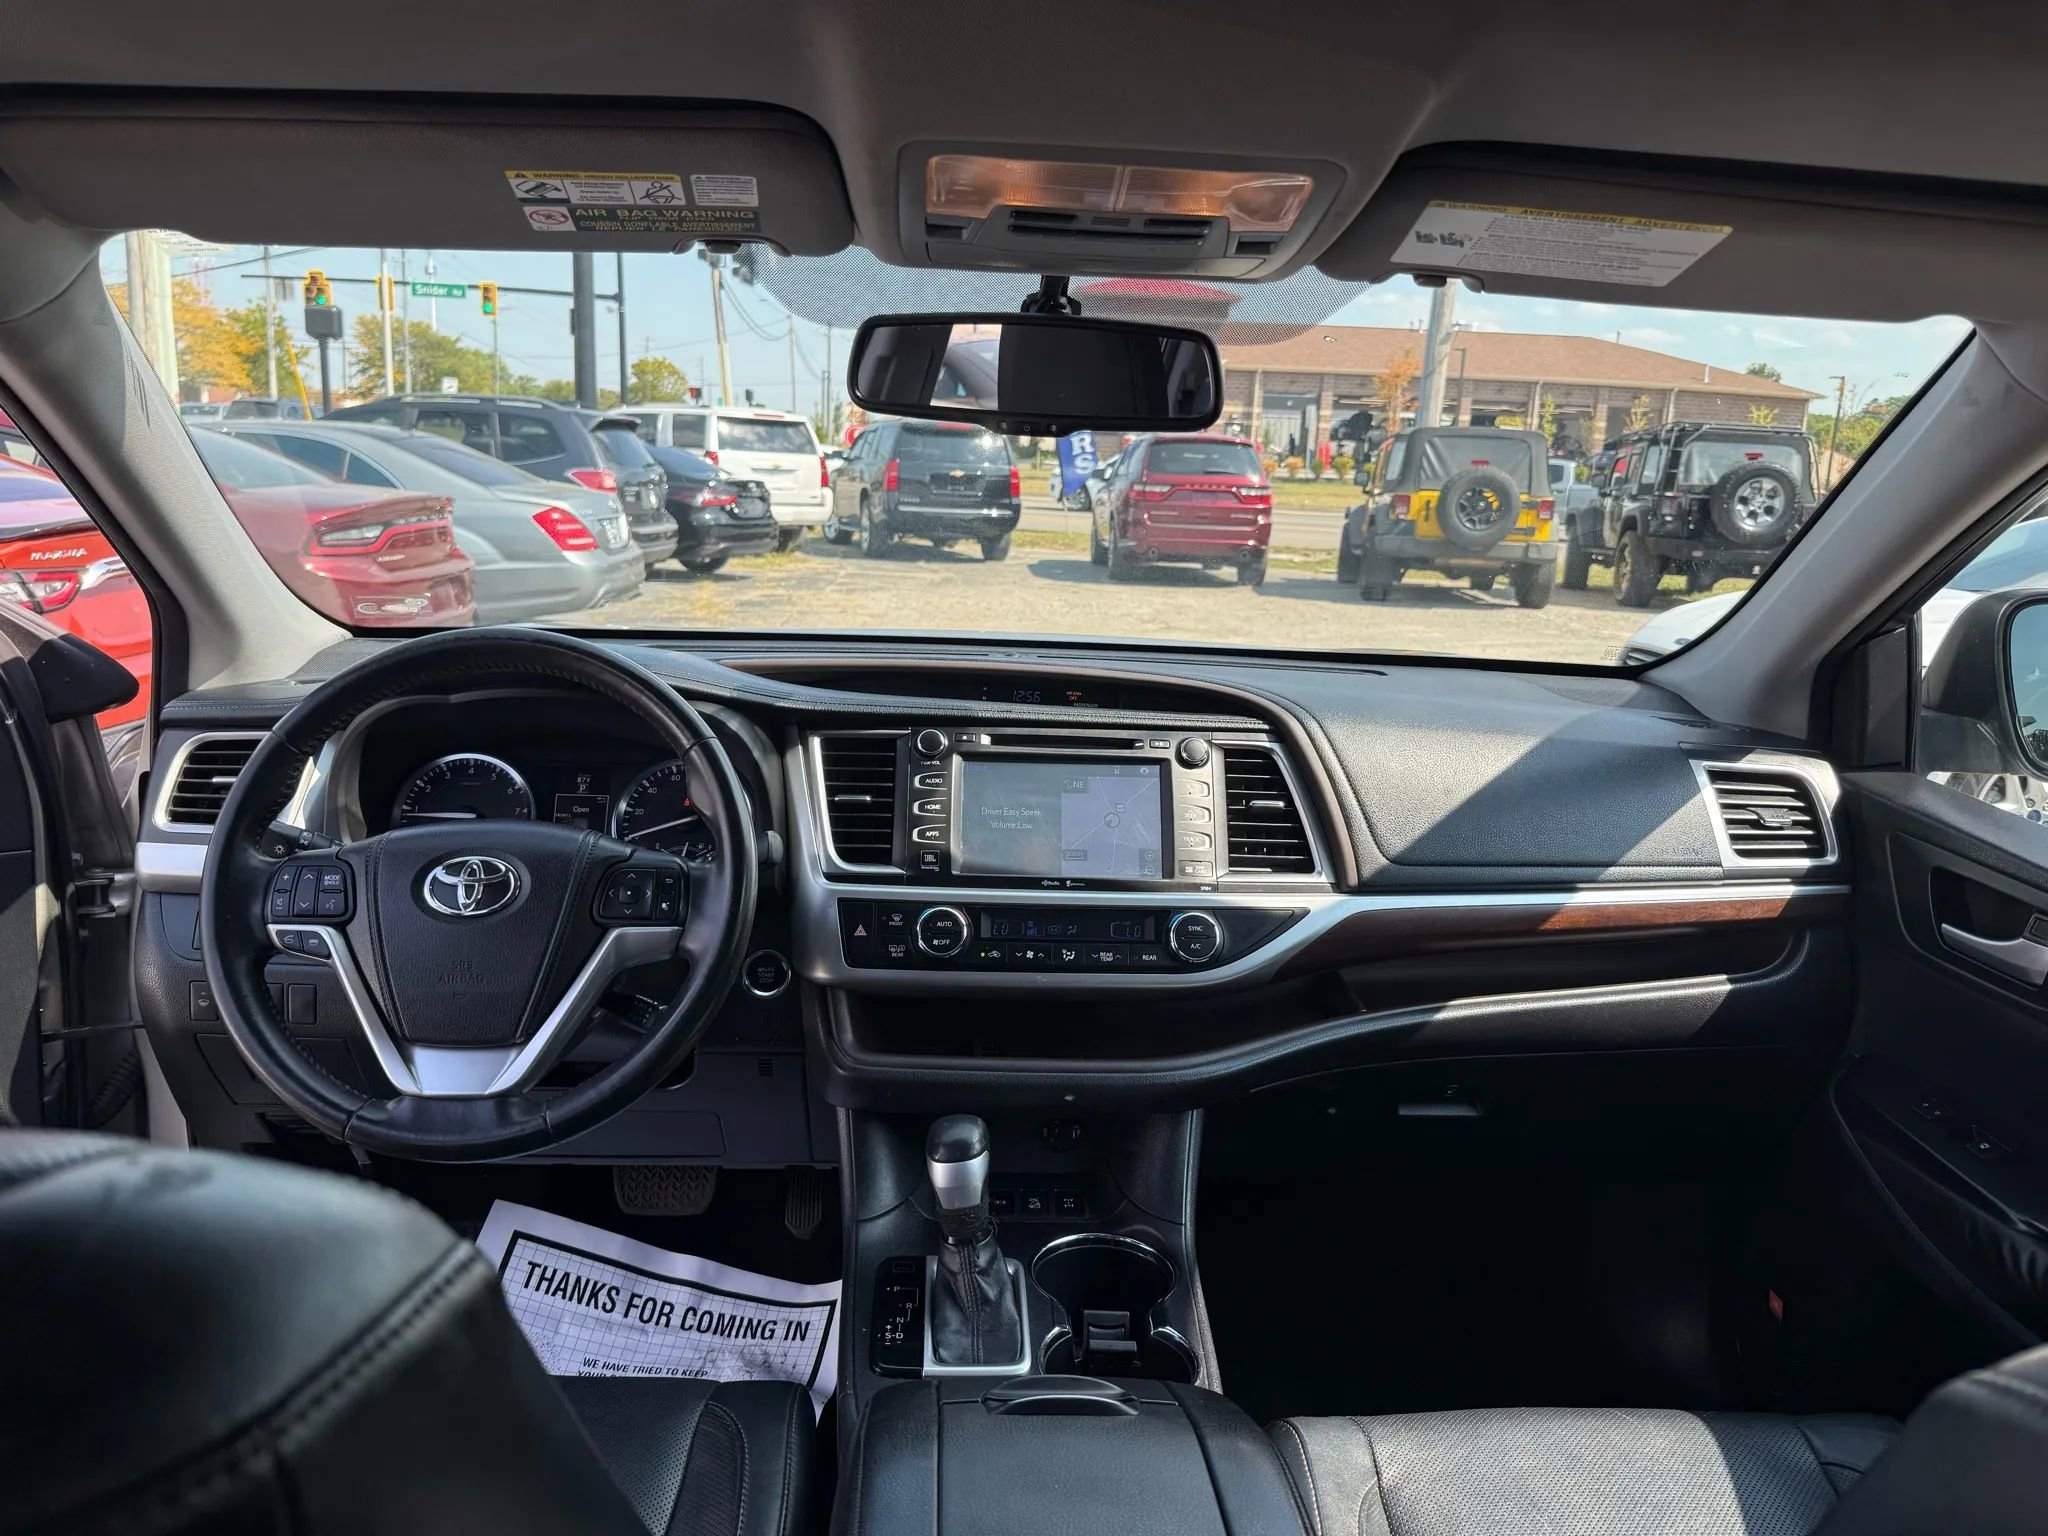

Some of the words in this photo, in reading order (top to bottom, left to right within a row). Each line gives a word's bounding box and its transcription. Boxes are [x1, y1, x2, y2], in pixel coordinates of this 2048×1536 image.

[575, 208, 608, 217] AIR
[616, 208, 658, 217] BAG
[662, 208, 755, 219] WARNING
[415, 284, 449, 296] Snider
[1012, 690, 1041, 703] 12:56
[491, 773, 497, 781] 5
[425, 785, 431, 793] 2
[507, 786, 514, 794] 6
[572, 805, 590, 814] Open
[634, 808, 645, 816] 20
[981, 806, 1002, 815] Driver
[1003, 807, 1019, 817] Easy
[1020, 807, 1042, 817] Speak
[924, 854, 936, 862] JBL
[523, 1261, 621, 1314] THANKS
[623, 1292, 676, 1329] FOR
[680, 1306, 778, 1341] COMING
[783, 1320, 811, 1342] IN
[582, 1356, 601, 1369] WE
[601, 1360, 631, 1373] HAVE
[632, 1364, 663, 1376] TRIED
[665, 1367, 679, 1376] TO
[681, 1369, 709, 1378] KEEP
